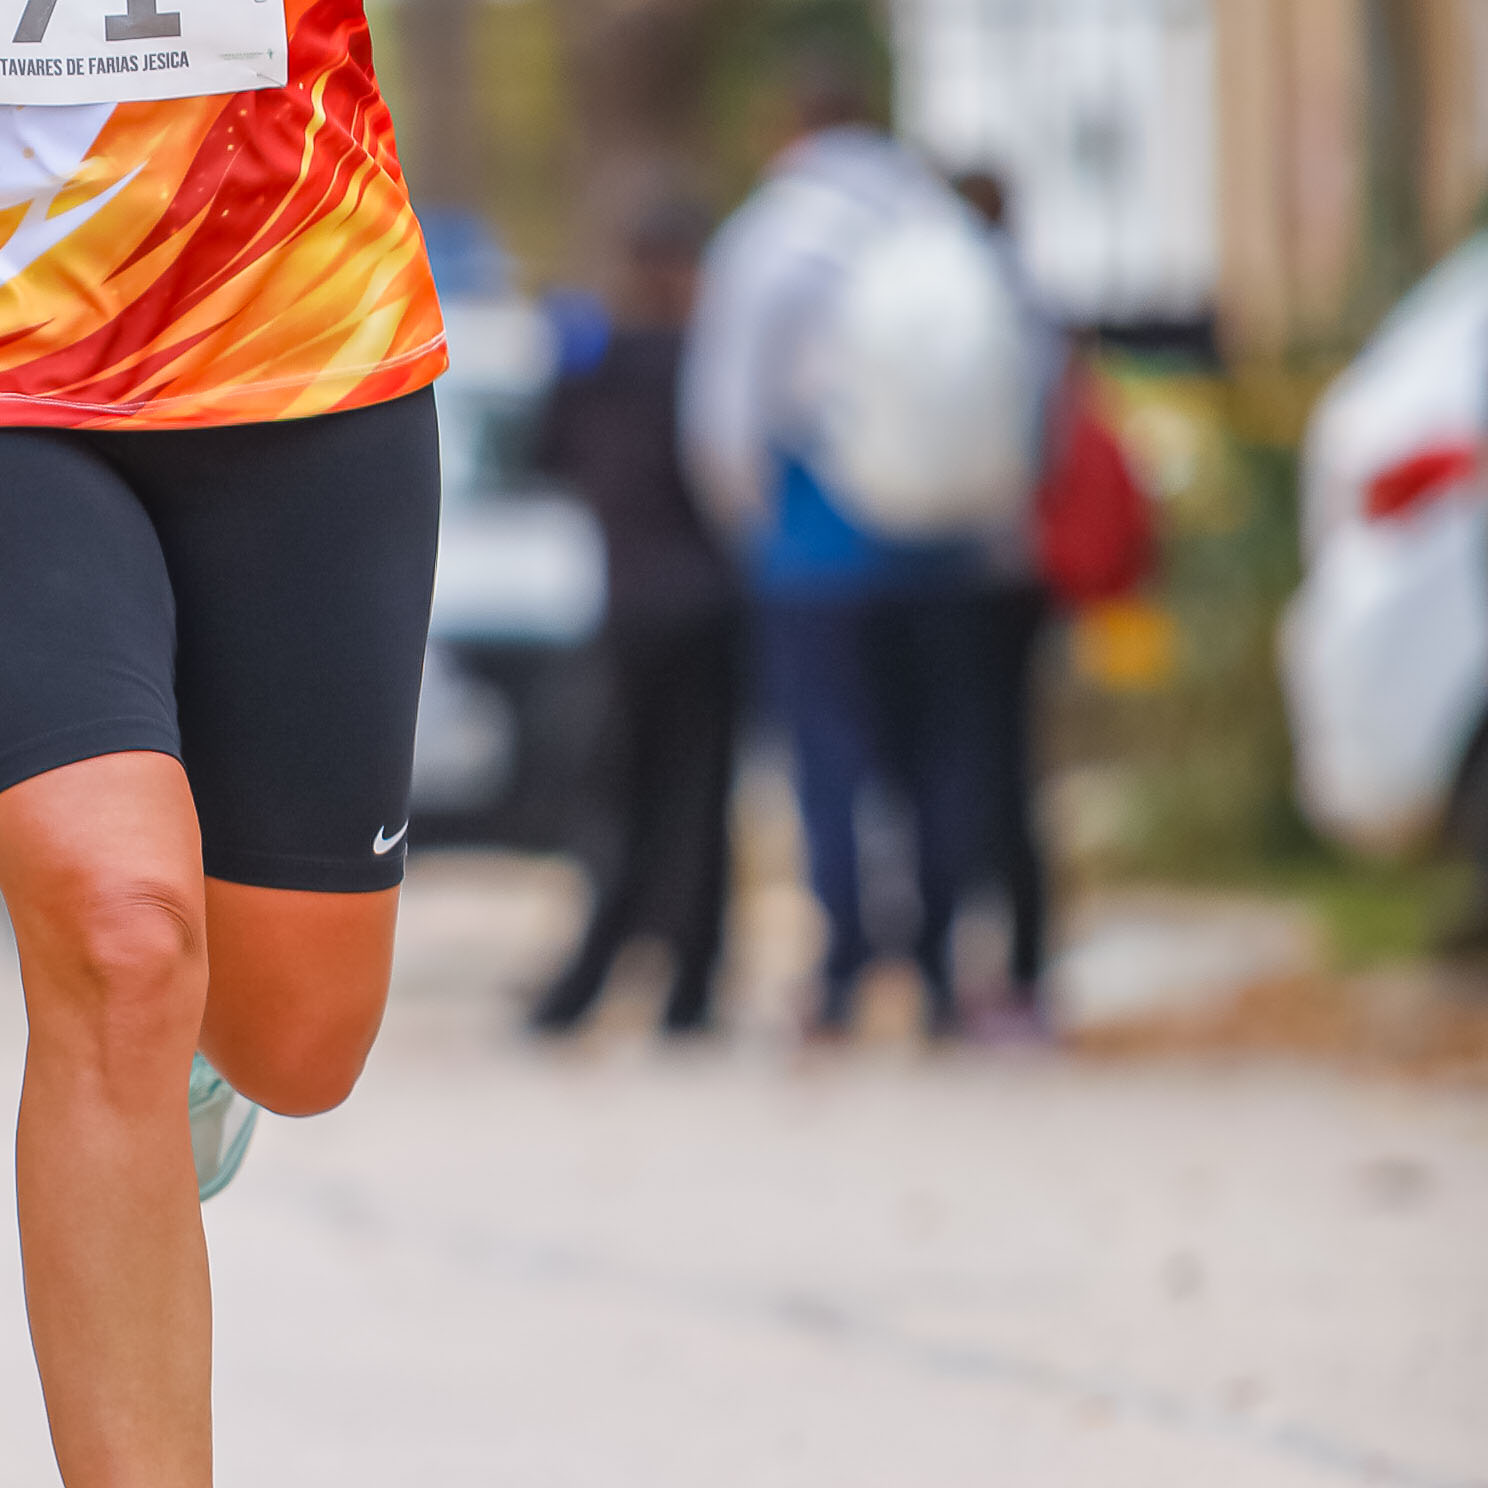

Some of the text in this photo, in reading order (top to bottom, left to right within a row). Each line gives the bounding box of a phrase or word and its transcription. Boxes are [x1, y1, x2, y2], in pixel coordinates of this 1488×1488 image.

[0, 50, 190, 76] TAVARES DE FARIAS JESICA
